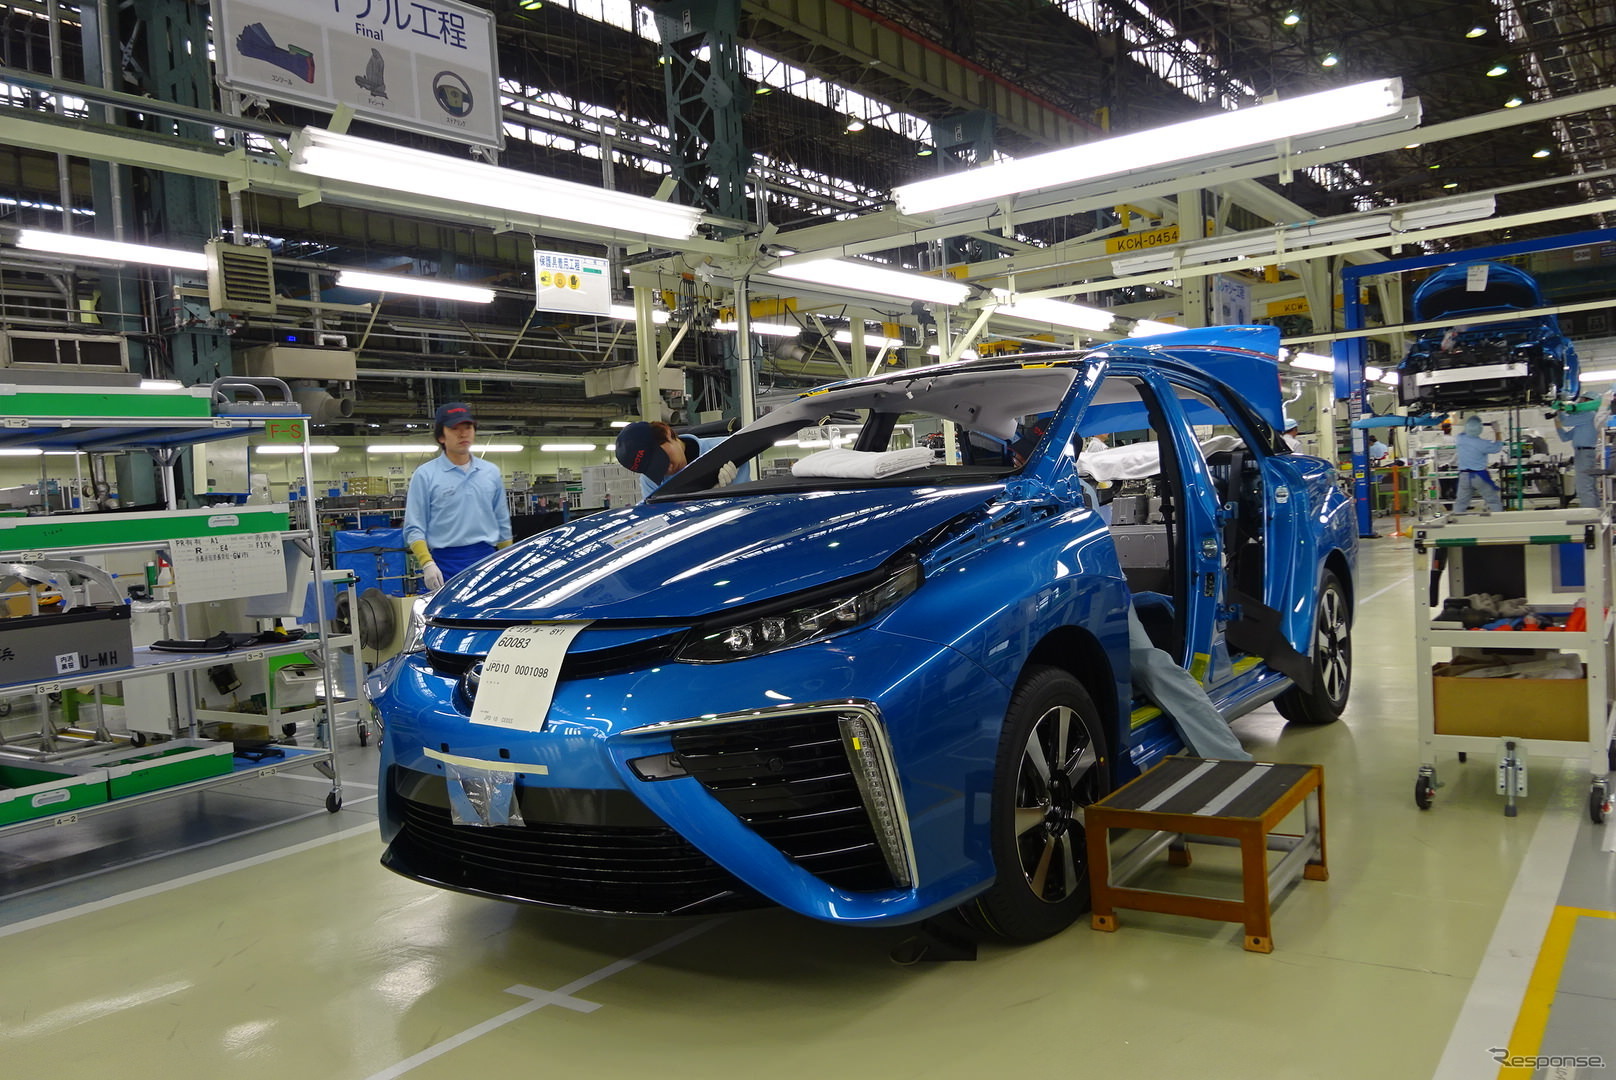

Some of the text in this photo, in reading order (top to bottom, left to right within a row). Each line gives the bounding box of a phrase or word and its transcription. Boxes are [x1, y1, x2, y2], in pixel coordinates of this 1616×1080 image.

[355, 22, 385, 42] Final
[1117, 231, 1179, 251] KCW-0454
[270, 424, 302, 439] F-S
[498, 637, 531, 649] 60083
[81, 650, 118, 669] U-MH
[486, 662, 549, 679] JPD10 0001098
[39, 684, 60, 694] 3-2
